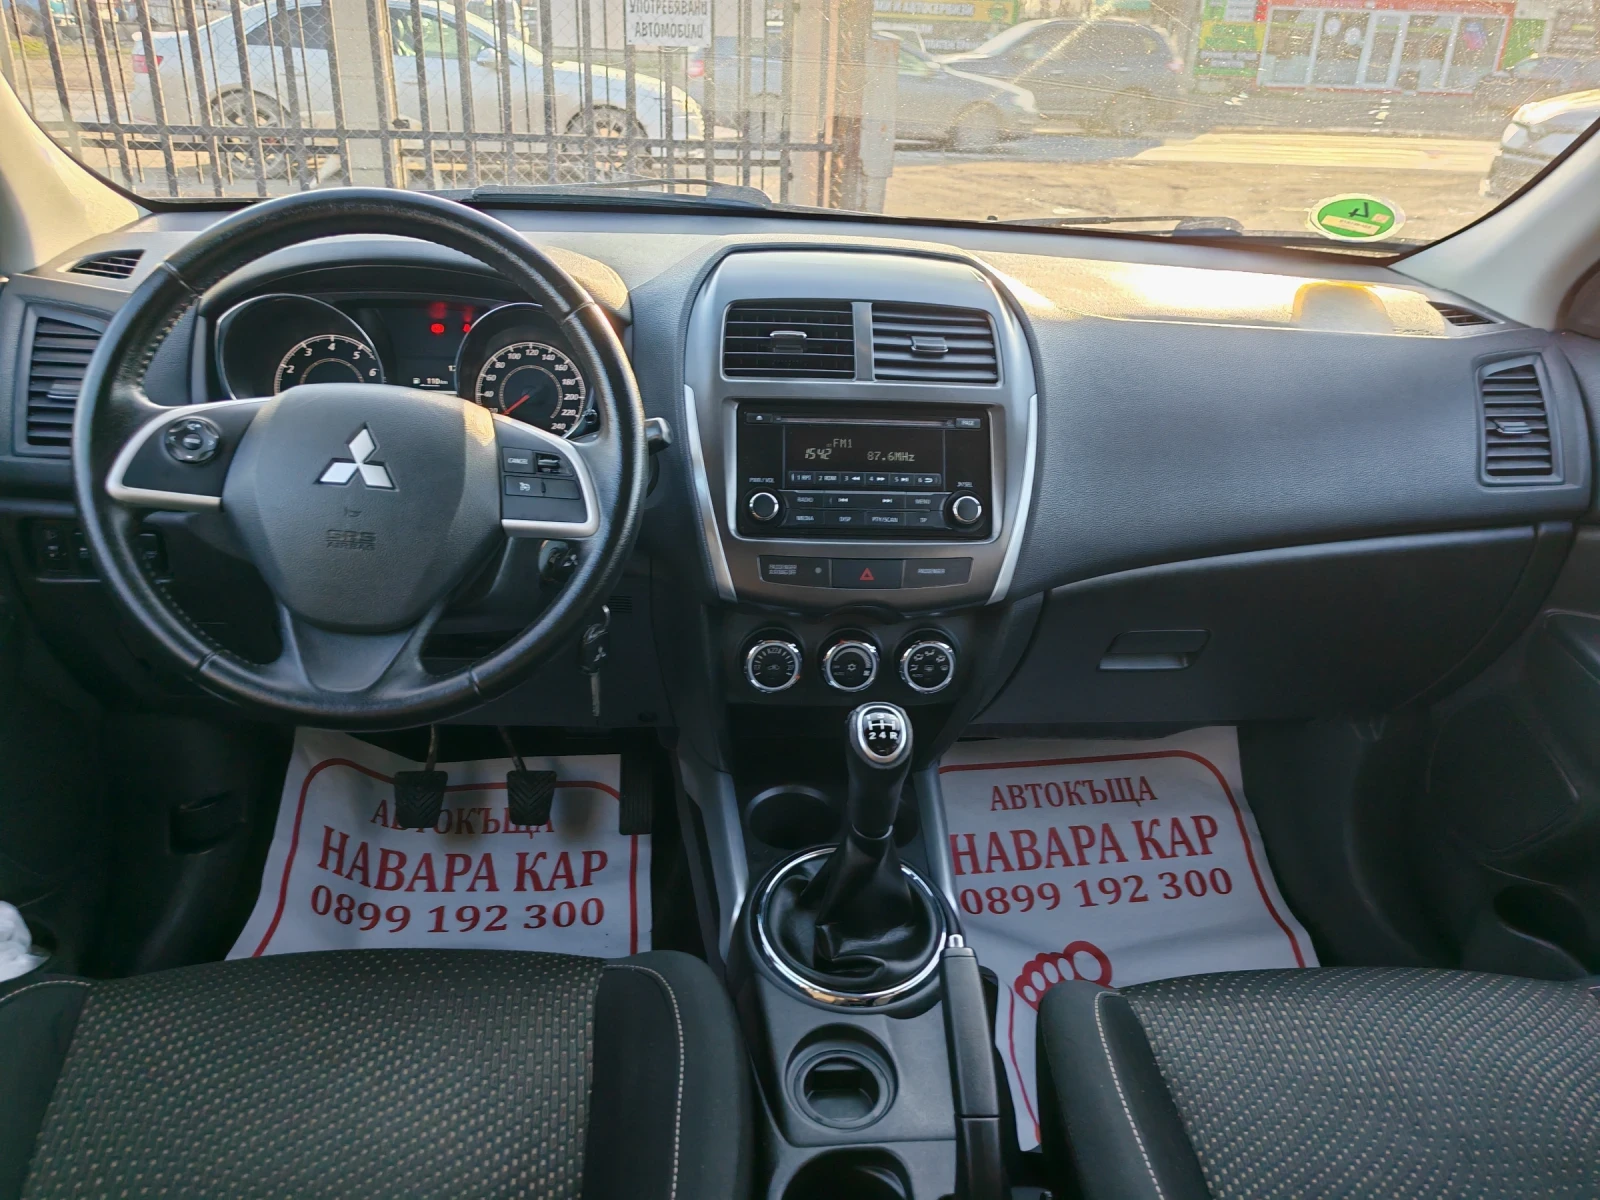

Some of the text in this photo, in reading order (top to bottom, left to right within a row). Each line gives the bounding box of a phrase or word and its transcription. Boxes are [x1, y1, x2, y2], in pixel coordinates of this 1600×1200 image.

[327, 342, 336, 351] 4
[304, 348, 313, 357] 3
[352, 351, 361, 360] 5
[285, 364, 295, 374] 2
[368, 368, 378, 377] 6
[562, 378, 576, 386] 180
[564, 393, 579, 401] 200
[561, 409, 577, 417] 220
[551, 423, 567, 431] 240
[832, 438, 853, 449] FM1
[866, 451, 916, 462] 87.6MHz
[868, 731, 898, 740] 2 4 R
[990, 775, 1158, 812] АВТОКЪЩА
[949, 814, 1219, 876] НАВАРА КАР
[317, 825, 608, 893] НАВАРА КАР
[959, 866, 1233, 915] 0899 192 300
[310, 884, 605, 933] 0899 192 300
